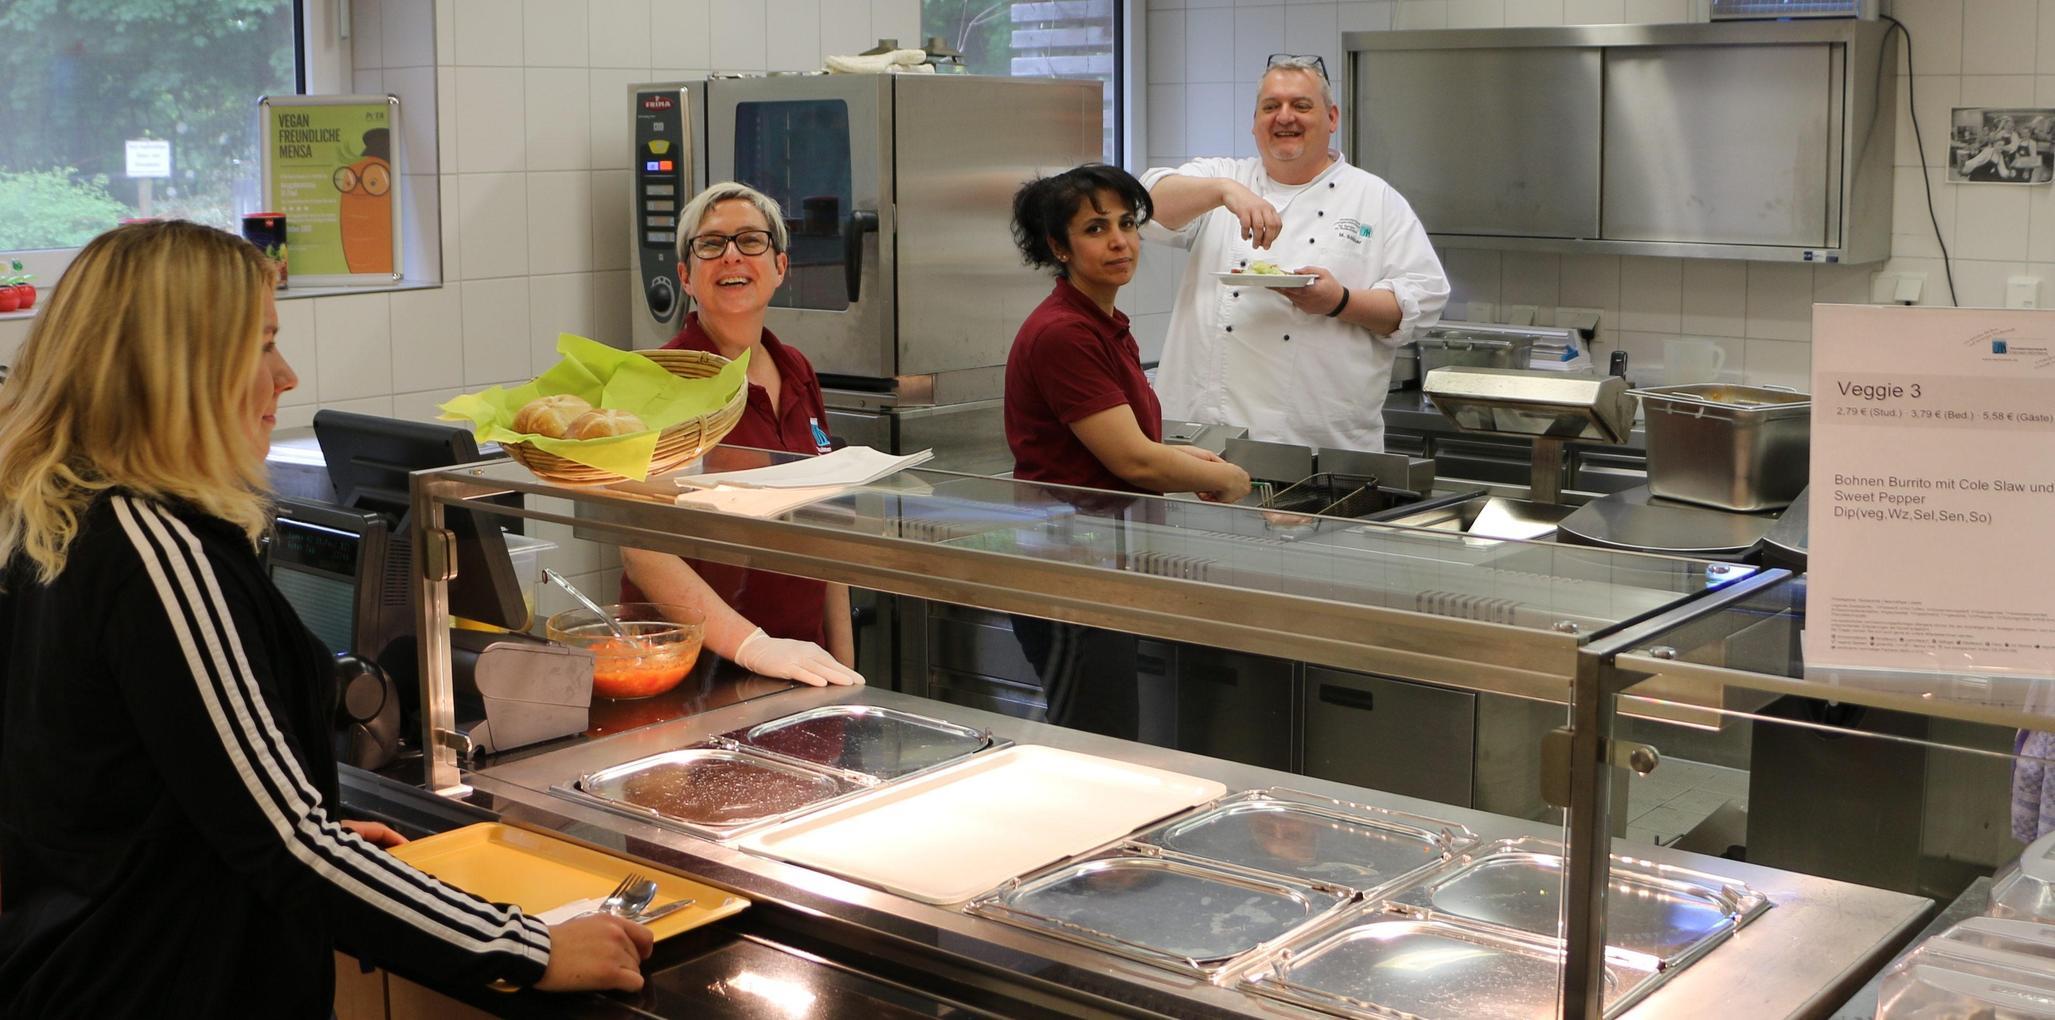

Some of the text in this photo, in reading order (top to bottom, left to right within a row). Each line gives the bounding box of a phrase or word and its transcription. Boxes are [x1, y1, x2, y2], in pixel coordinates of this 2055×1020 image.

[645, 100, 671, 108] FRIMA
[279, 114, 309, 128] VEGAN
[279, 128, 341, 143] FREUNDLICHE
[279, 144, 312, 158] MENSA
[1838, 381, 1922, 400] Veggie 3
[1836, 407, 1858, 416] 2,79
[1869, 408, 1903, 418] (Stud.)
[1911, 410, 1932, 419] 3,79
[1834, 474, 2055, 493] Bohnen Burrito mit Cole Slaw und
[1834, 490, 1926, 505] Sweet Pepper
[1834, 505, 1992, 525] Dip(veg,Wz,Sel,Sen,So)
